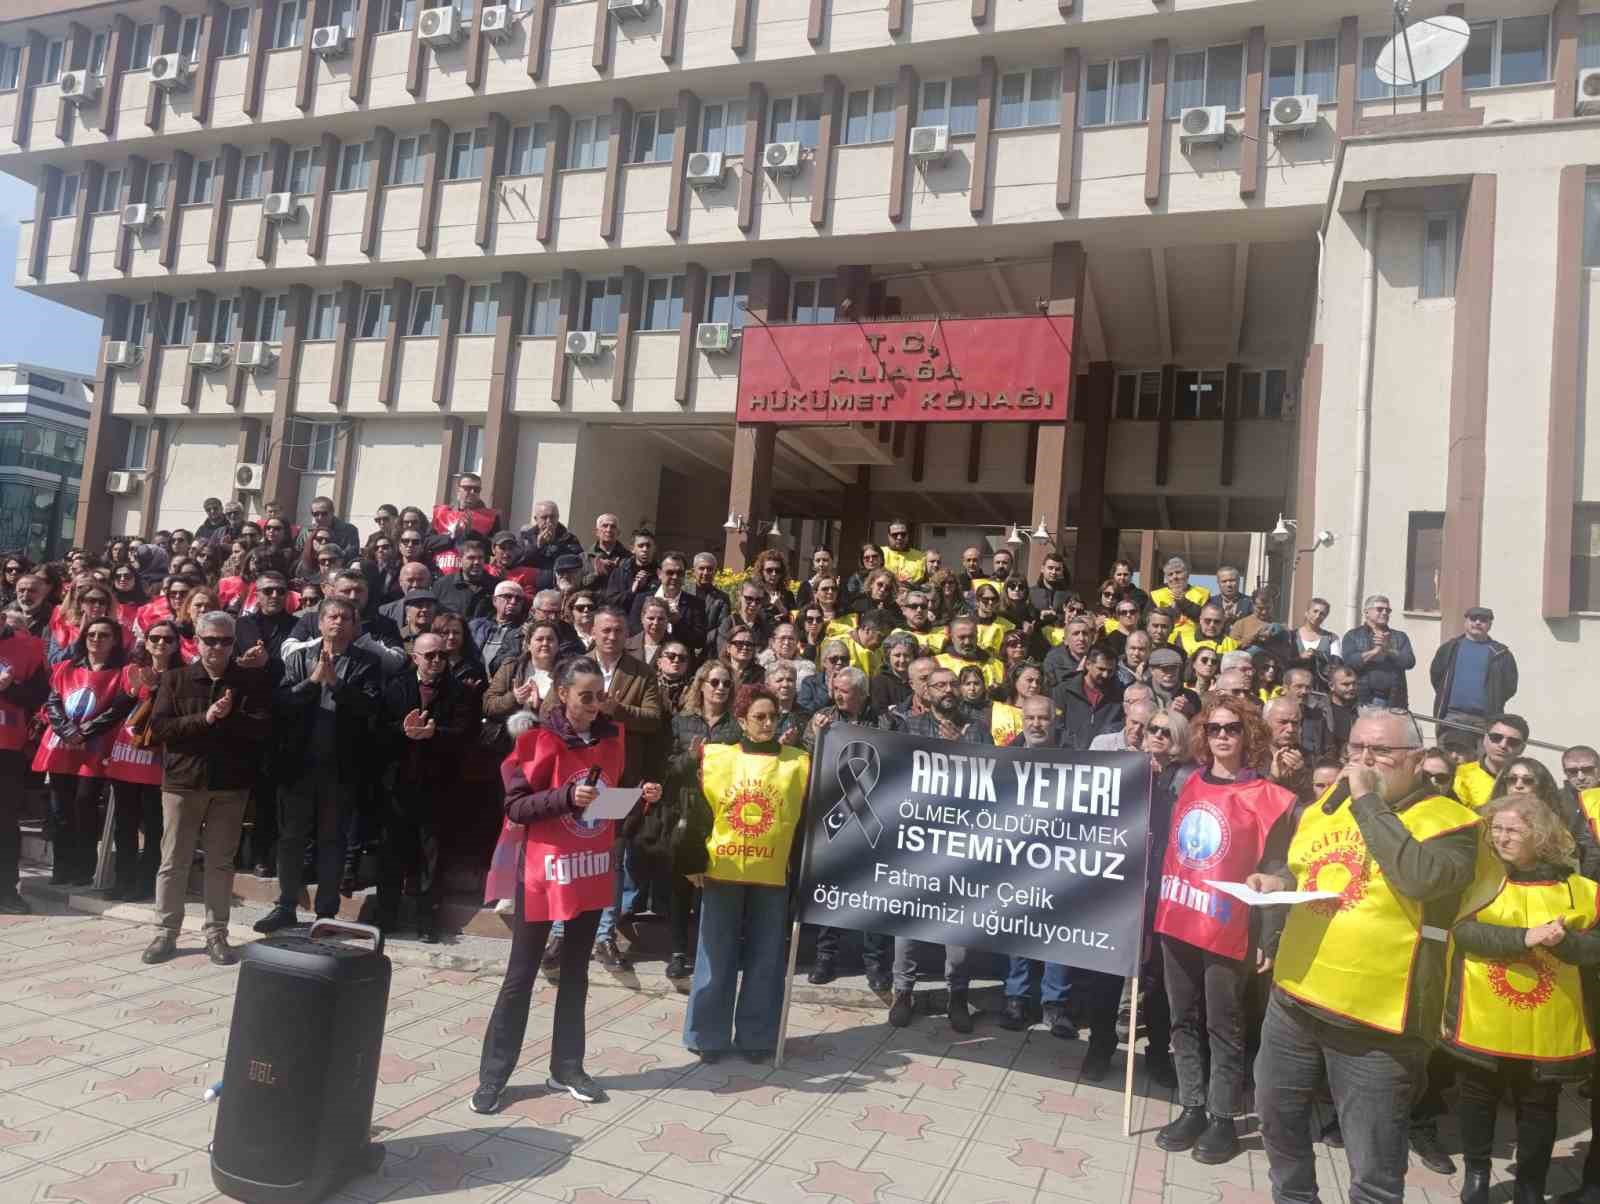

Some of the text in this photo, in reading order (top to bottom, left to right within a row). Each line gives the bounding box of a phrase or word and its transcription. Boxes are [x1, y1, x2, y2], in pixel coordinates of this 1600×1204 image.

[750, 386, 1055, 413] HÜKÜMET KONAĞI
[911, 750, 1122, 817] ARTIK YETER!
[544, 850, 610, 886] Eğitim
[874, 862, 1056, 910] Fatma Nur Çelik
[813, 884, 1117, 951] öğretmenimizi uğurluyoruz.
[248, 1059, 278, 1084] JBL
